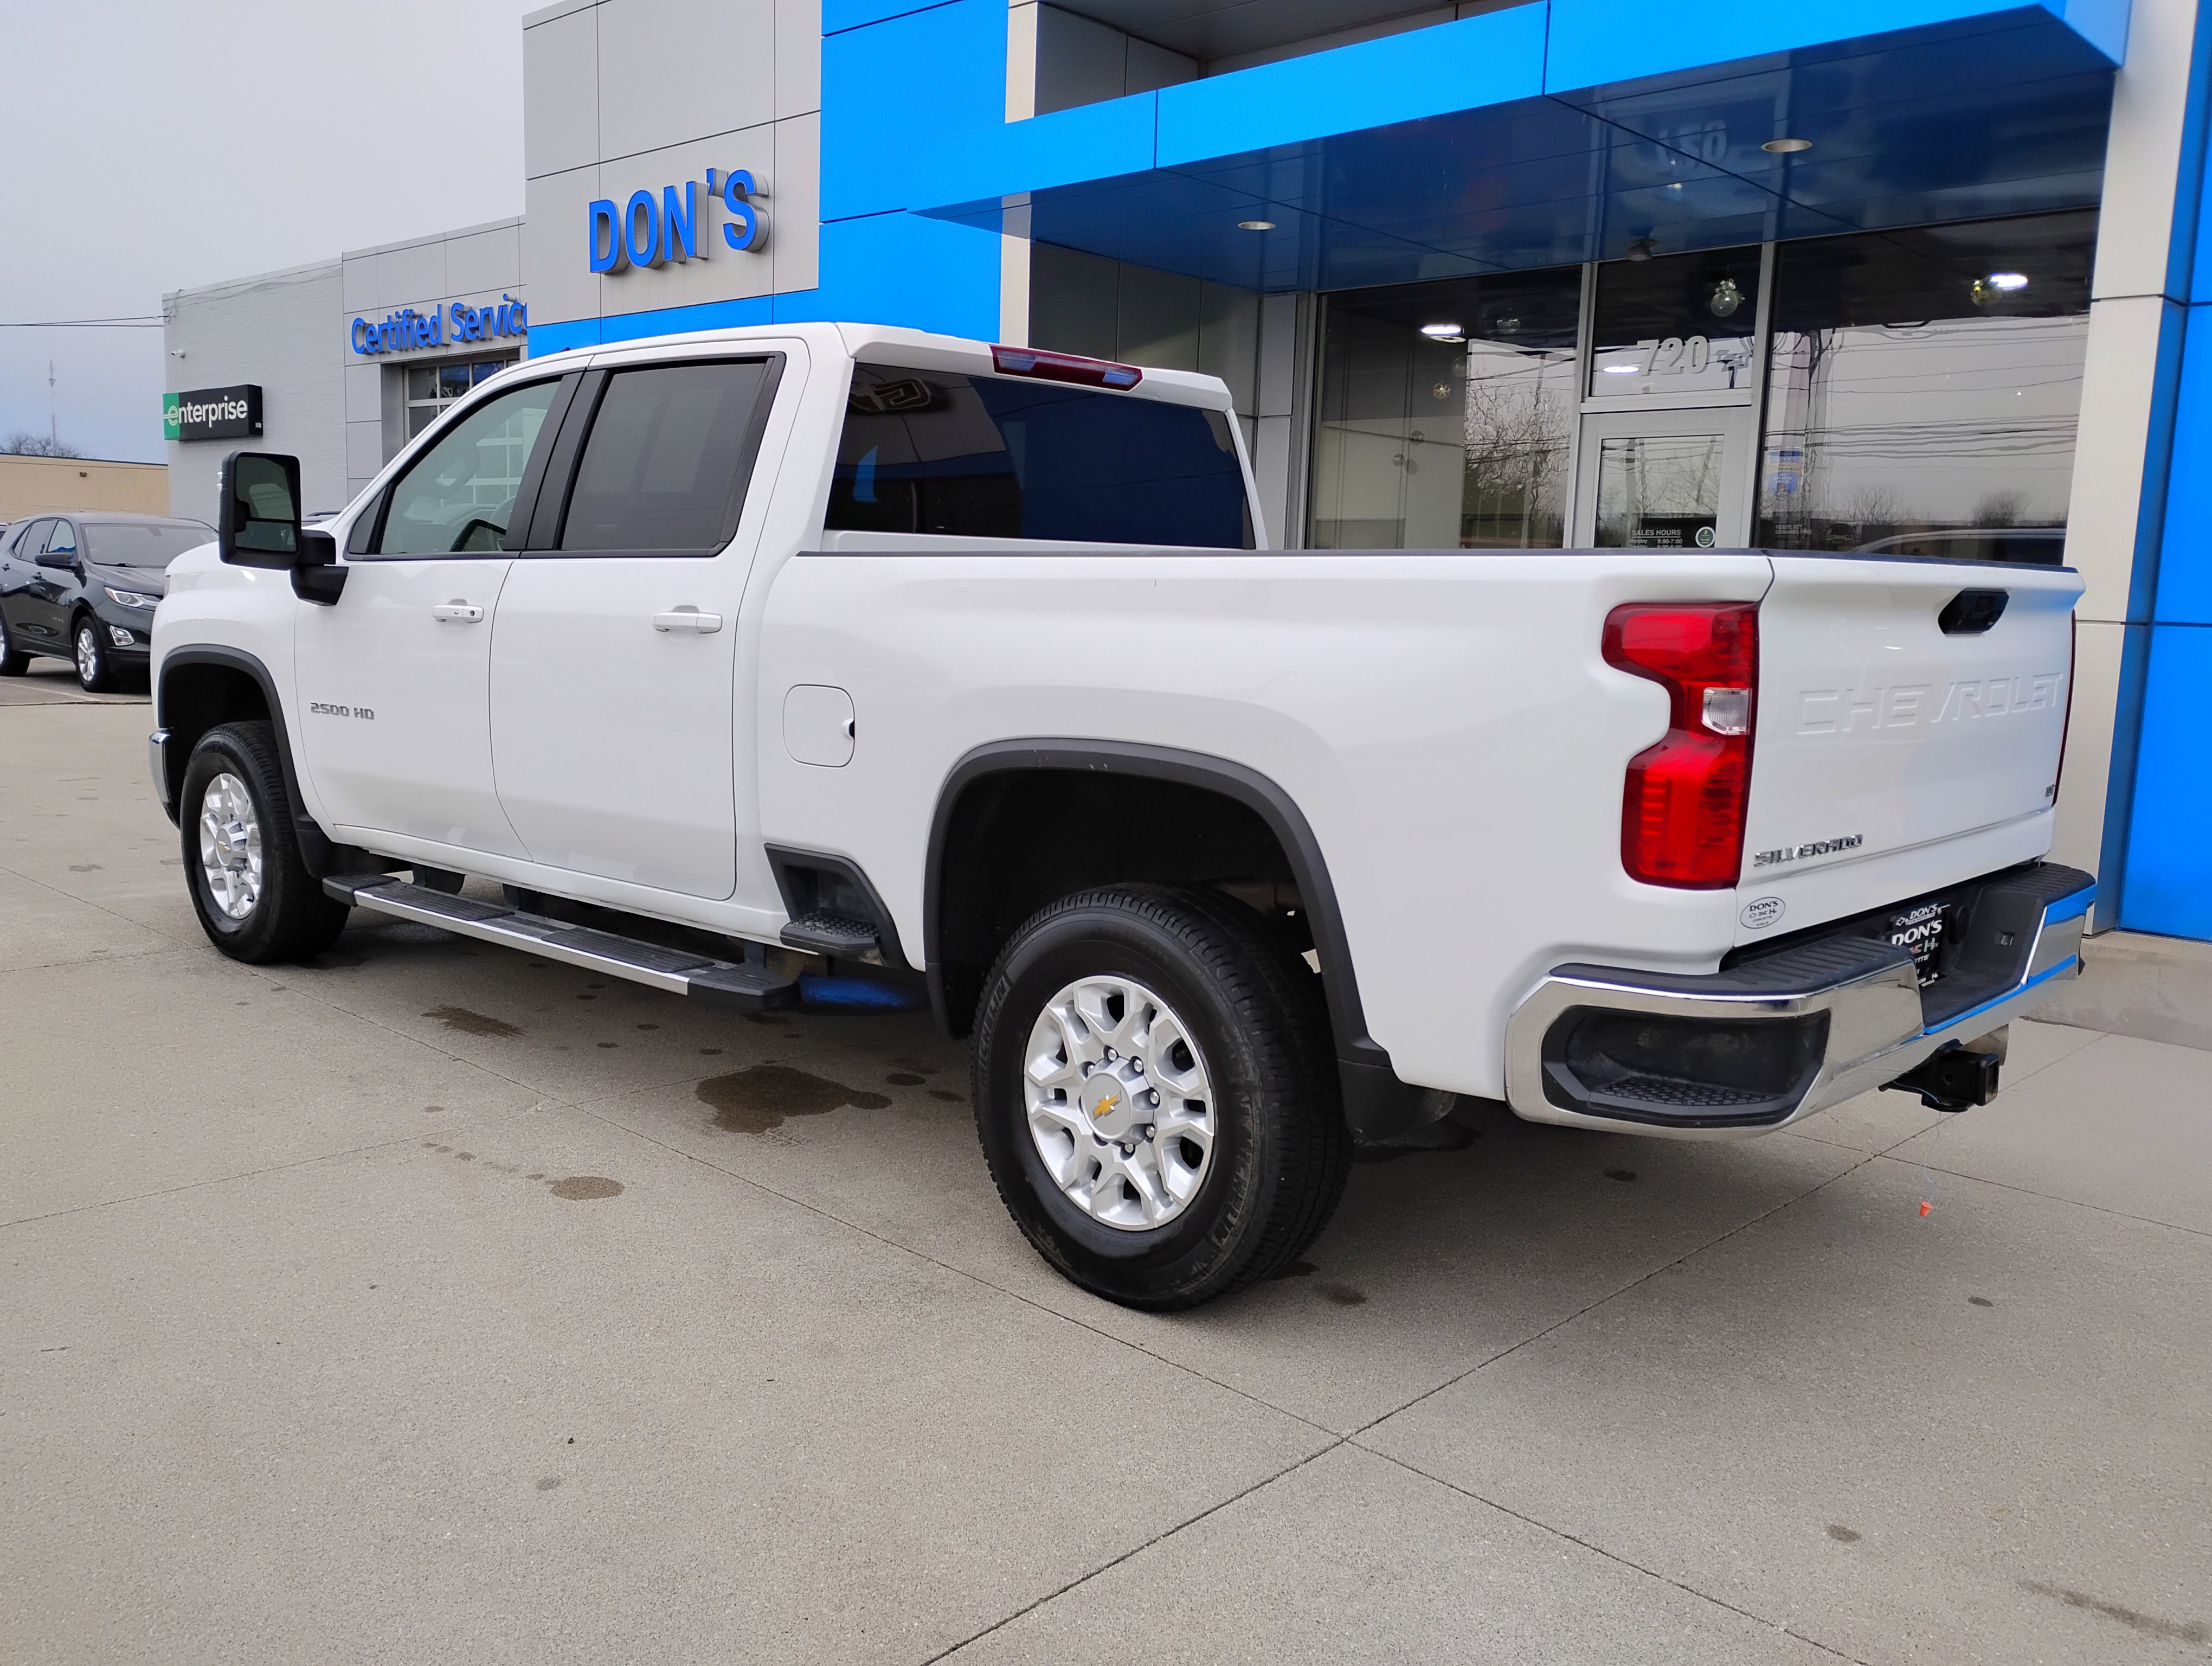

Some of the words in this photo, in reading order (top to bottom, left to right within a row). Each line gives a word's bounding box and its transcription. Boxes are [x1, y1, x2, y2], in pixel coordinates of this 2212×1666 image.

[589, 168, 766, 274] DON'S
[351, 303, 444, 354] Certified
[451, 293, 528, 342] Servic
[1637, 335, 1709, 376] 720
[164, 395, 247, 428] enterprise
[310, 702, 350, 717] 2500
[353, 707, 375, 720] HD
[1753, 834, 1863, 868] SILVERADO
[1750, 900, 1778, 912] DON'S
[1909, 903, 1938, 920] DON'S
[1892, 919, 1943, 946] DON'S
